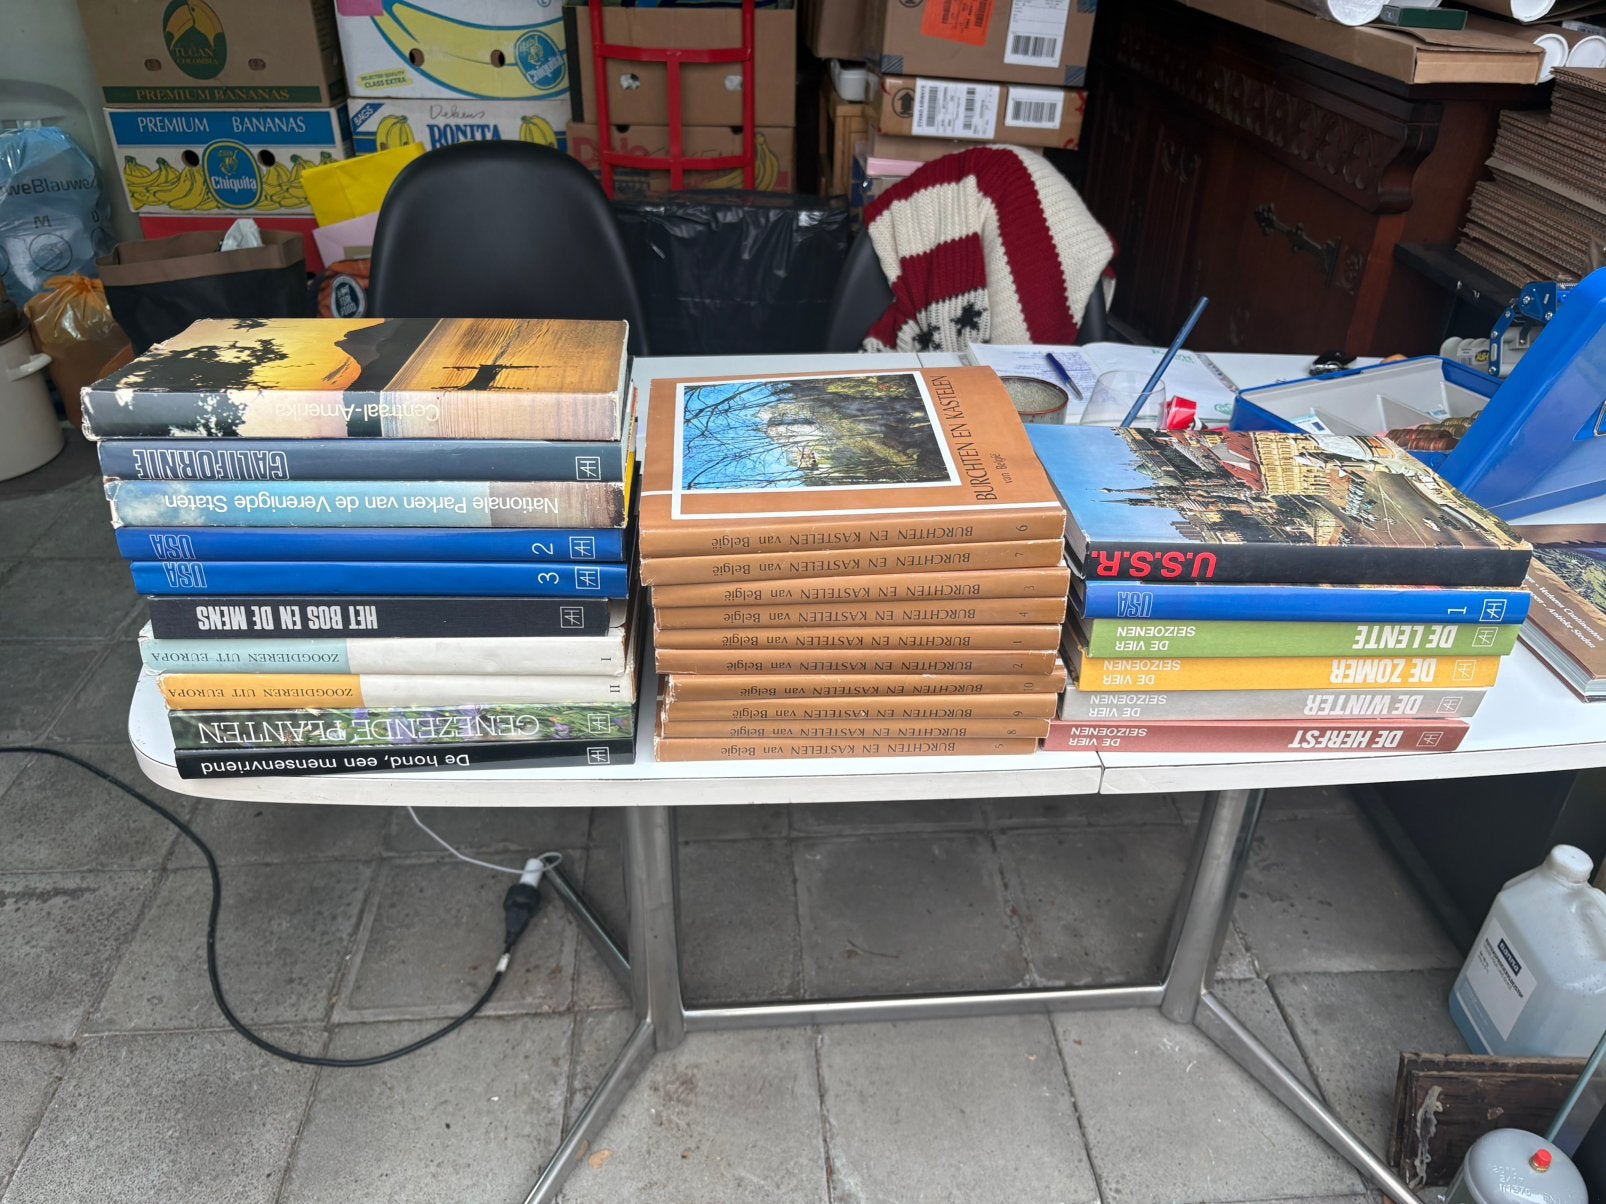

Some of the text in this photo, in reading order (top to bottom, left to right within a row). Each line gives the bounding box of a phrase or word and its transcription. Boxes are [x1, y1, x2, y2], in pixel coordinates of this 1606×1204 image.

[364, 76, 407, 88] CLASS EXTRA
[136, 90, 289, 100] PREMIUM BANANAS
[353, 105, 374, 126] BAGS
[137, 116, 306, 132] PREMIUM BANANAS
[211, 175, 257, 192] Chiquita
[930, 375, 998, 501] BURCHTEN EN KASTELEN
[132, 449, 290, 480] CALIFORNIE
[1001, 472, 1013, 484] van
[166, 492, 558, 513] Nationale Parken van de Verenigde Staten
[789, 531, 861, 545] KASTELEN
[869, 530, 889, 541] EN
[897, 526, 973, 541] BURCHTEN
[759, 535, 781, 545] van
[149, 534, 196, 560] USA
[532, 542, 553, 555] 2
[868, 557, 887, 568] EN
[896, 552, 971, 566] BURCHTEN
[1091, 551, 1218, 578] U.S.S.R.
[759, 563, 781, 572] van
[790, 559, 860, 571] KASTELEN
[162, 561, 208, 588] USA
[538, 572, 559, 585] 3
[770, 589, 793, 599] van
[800, 587, 870, 600] KASTELEN
[878, 586, 897, 597] EN
[906, 584, 980, 596] BURCHTEN
[1117, 591, 1154, 618] USA
[799, 610, 867, 622] KASTELEN
[875, 610, 894, 621] EN
[902, 608, 976, 620] BURCHTEN
[1448, 606, 1467, 615] 1
[196, 605, 378, 631] HET BOS EN DE MENS
[769, 612, 790, 621] van
[1116, 626, 1197, 637] SEIZOENEN
[766, 636, 788, 645] van
[796, 636, 863, 646] KASTELEN
[871, 636, 890, 646] EN
[899, 636, 970, 646] BURCHTEN
[1352, 625, 1459, 650] DE LENTE
[1115, 640, 1169, 651] DE VIER
[151, 652, 340, 663] ZOOGDIEREN UIT EUROPA
[771, 661, 792, 669] van
[800, 661, 866, 671] KASTELEN
[874, 661, 893, 671] EN
[901, 661, 973, 671] BURCHTEN
[1103, 659, 1181, 671] SEIZOENEN
[1330, 658, 1437, 684] DE ZOMER
[1102, 674, 1155, 685] DE VIER
[168, 688, 353, 698] ZOOGDIEREN UIT EUROPA
[812, 686, 879, 696] KASTELEN
[886, 685, 905, 694] EN
[913, 684, 983, 694] BURCHTEN
[1090, 694, 1168, 705] SEIZOENEN
[1303, 694, 1425, 716] DE WINTER
[775, 709, 796, 717] van
[803, 709, 869, 719] KASTELEN
[876, 709, 894, 718] EN
[902, 709, 972, 718] BURCHTEN
[1089, 707, 1141, 717] DE VIER
[199, 715, 540, 744] GENEZENDE PLANTEN
[800, 727, 865, 737] KASTELEN
[872, 727, 890, 736] EN
[898, 727, 967, 736] BURCHTEN
[1070, 727, 1148, 737] SEIZOENEN
[1069, 737, 1120, 747] DE VIER
[1288, 730, 1404, 748] DE HERFST
[763, 746, 783, 754] van
[791, 744, 855, 755] KASTELEN
[862, 743, 879, 753] EN
[887, 742, 955, 752] BURCHTEN
[201, 754, 470, 775] De hond, een mensenvriend
